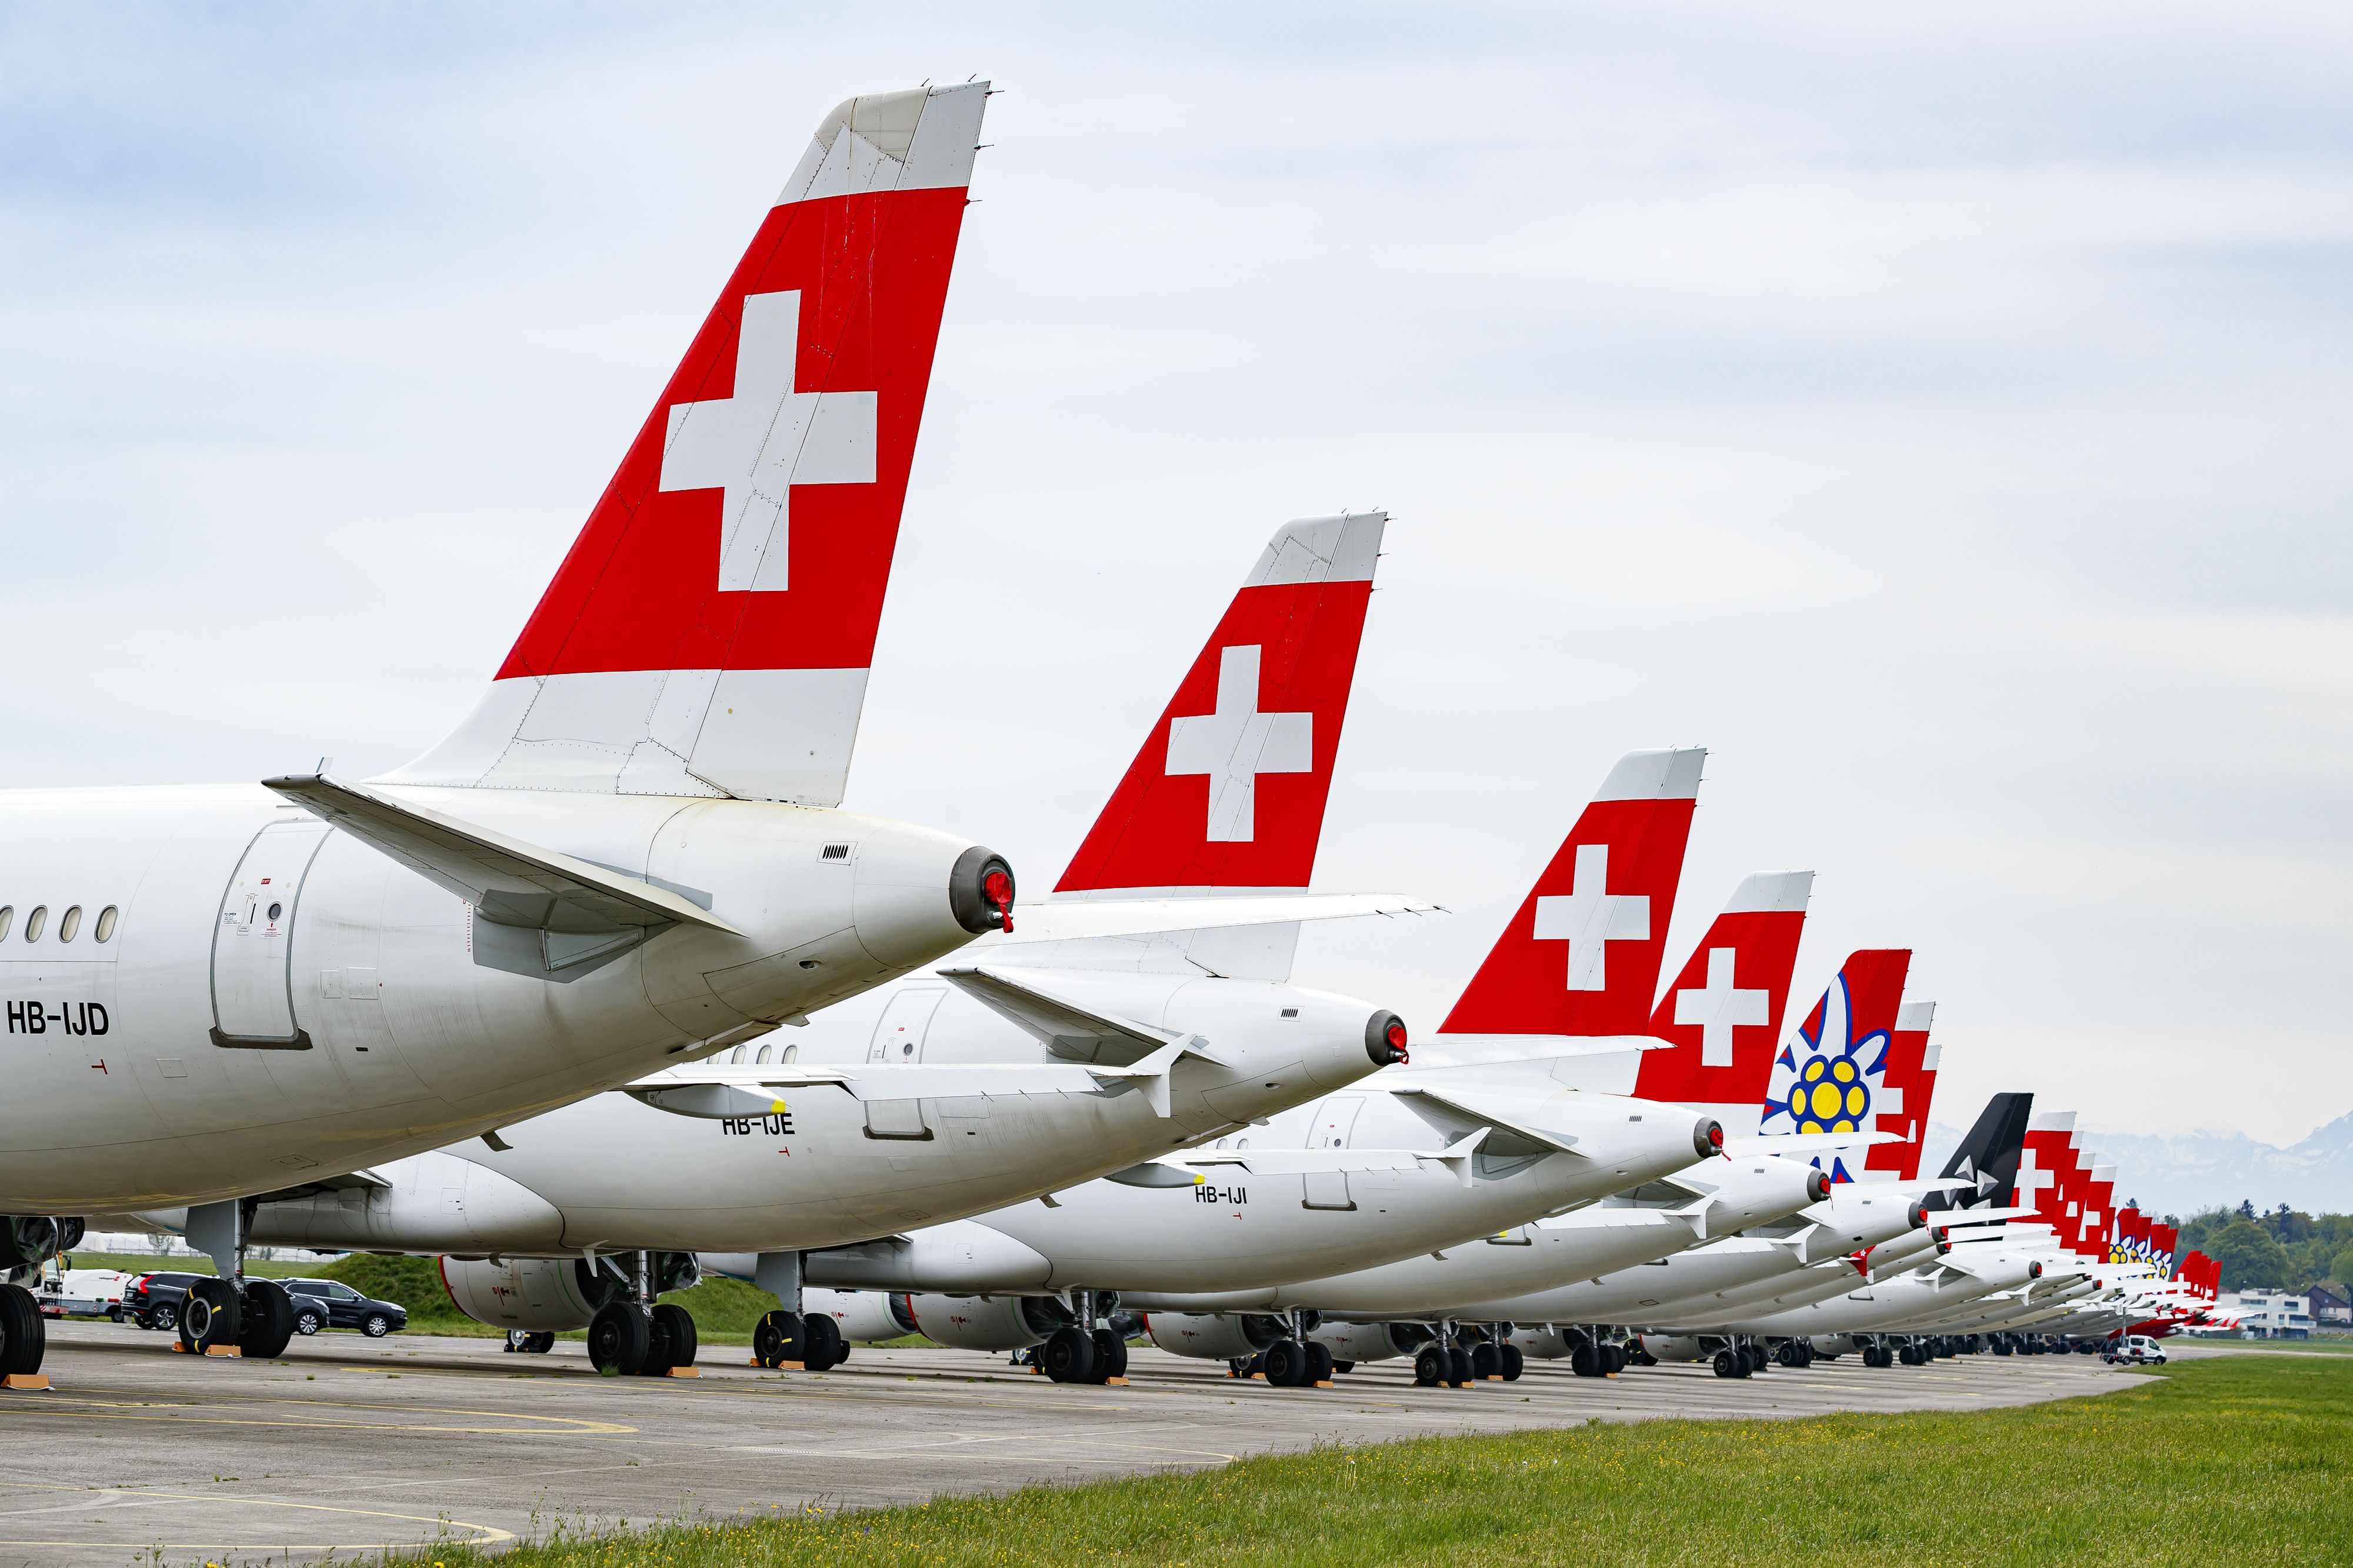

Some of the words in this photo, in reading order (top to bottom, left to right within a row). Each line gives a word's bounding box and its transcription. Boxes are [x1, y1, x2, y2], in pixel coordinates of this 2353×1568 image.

[7, 1000, 109, 1036] HB-IJD
[722, 1113, 795, 1135] HB-IJE
[1195, 1186, 1247, 1204] HB-IJI
